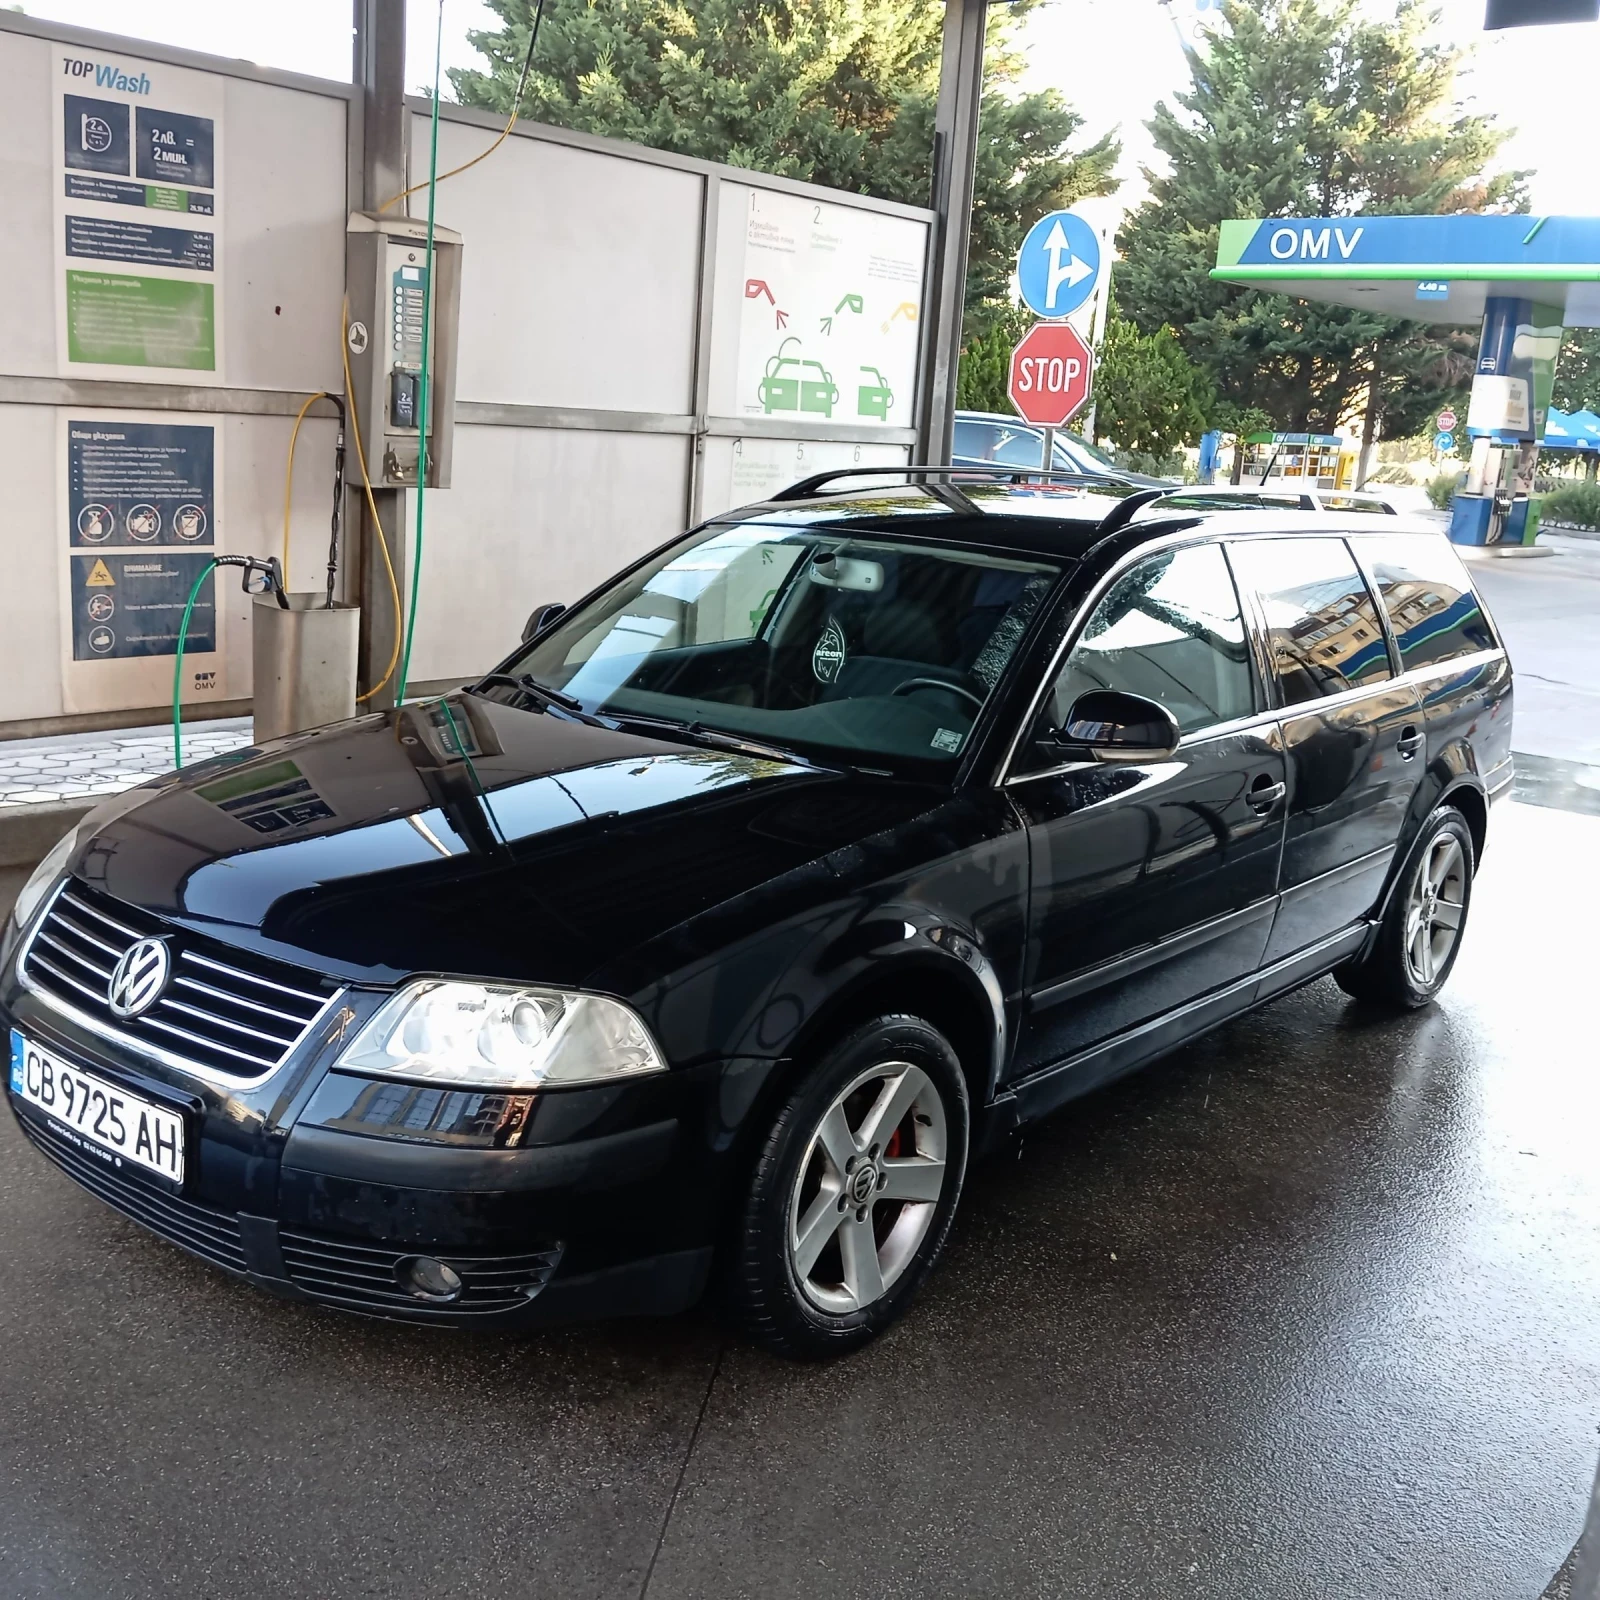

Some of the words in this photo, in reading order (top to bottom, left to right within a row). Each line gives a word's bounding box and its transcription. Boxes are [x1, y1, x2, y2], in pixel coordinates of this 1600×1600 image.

[1269, 227, 1364, 260] OMV
[1018, 357, 1081, 393] STOP
[815, 649, 843, 658] areon
[194, 681, 216, 691] OMV
[27, 1051, 55, 1107] CB
[60, 1072, 126, 1146] 9725
[135, 1111, 176, 1173] AH
